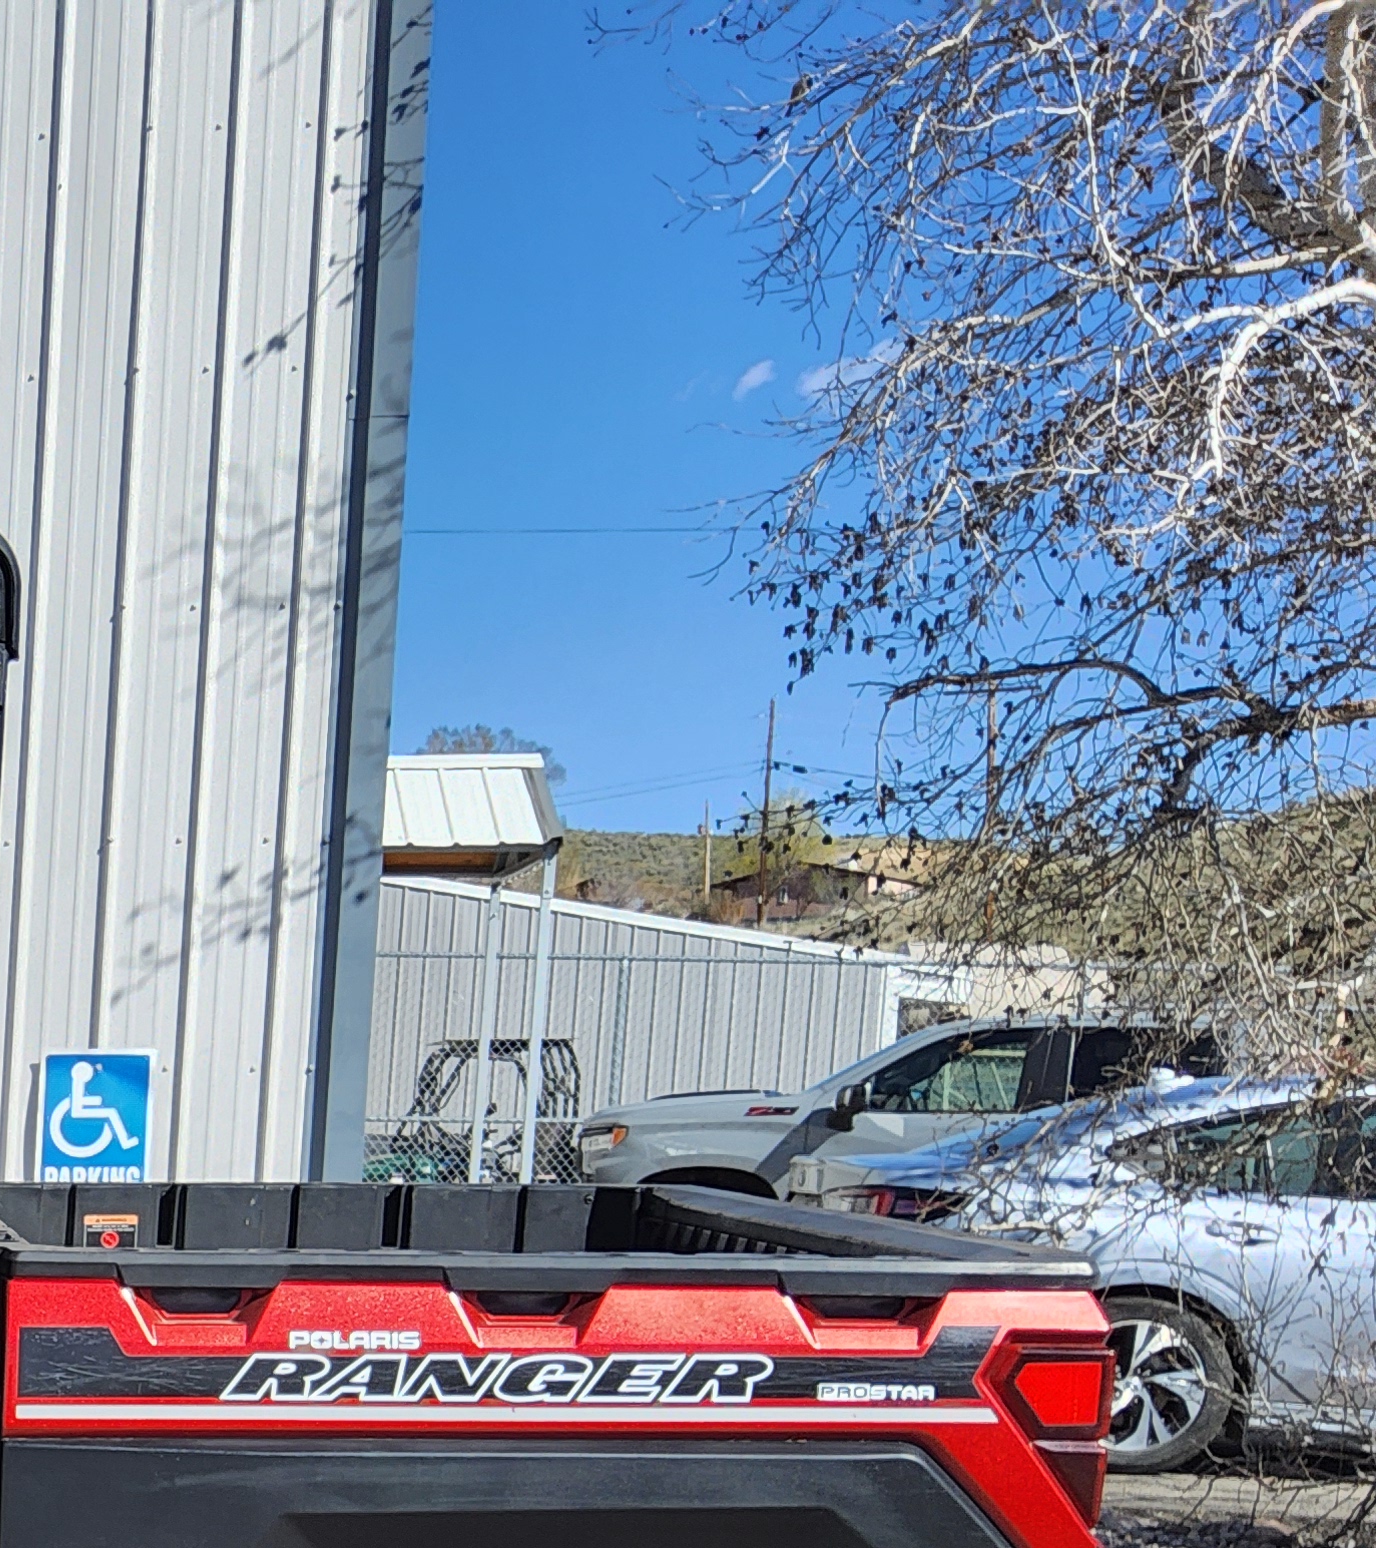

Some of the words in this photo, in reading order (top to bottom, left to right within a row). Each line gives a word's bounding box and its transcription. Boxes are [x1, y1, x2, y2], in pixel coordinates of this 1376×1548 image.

[44, 1165, 141, 1183] PARKING
[288, 1330, 422, 1350] POLARIS
[219, 1352, 775, 1403] RANGER
[817, 1382, 937, 1402] PROSTAR
